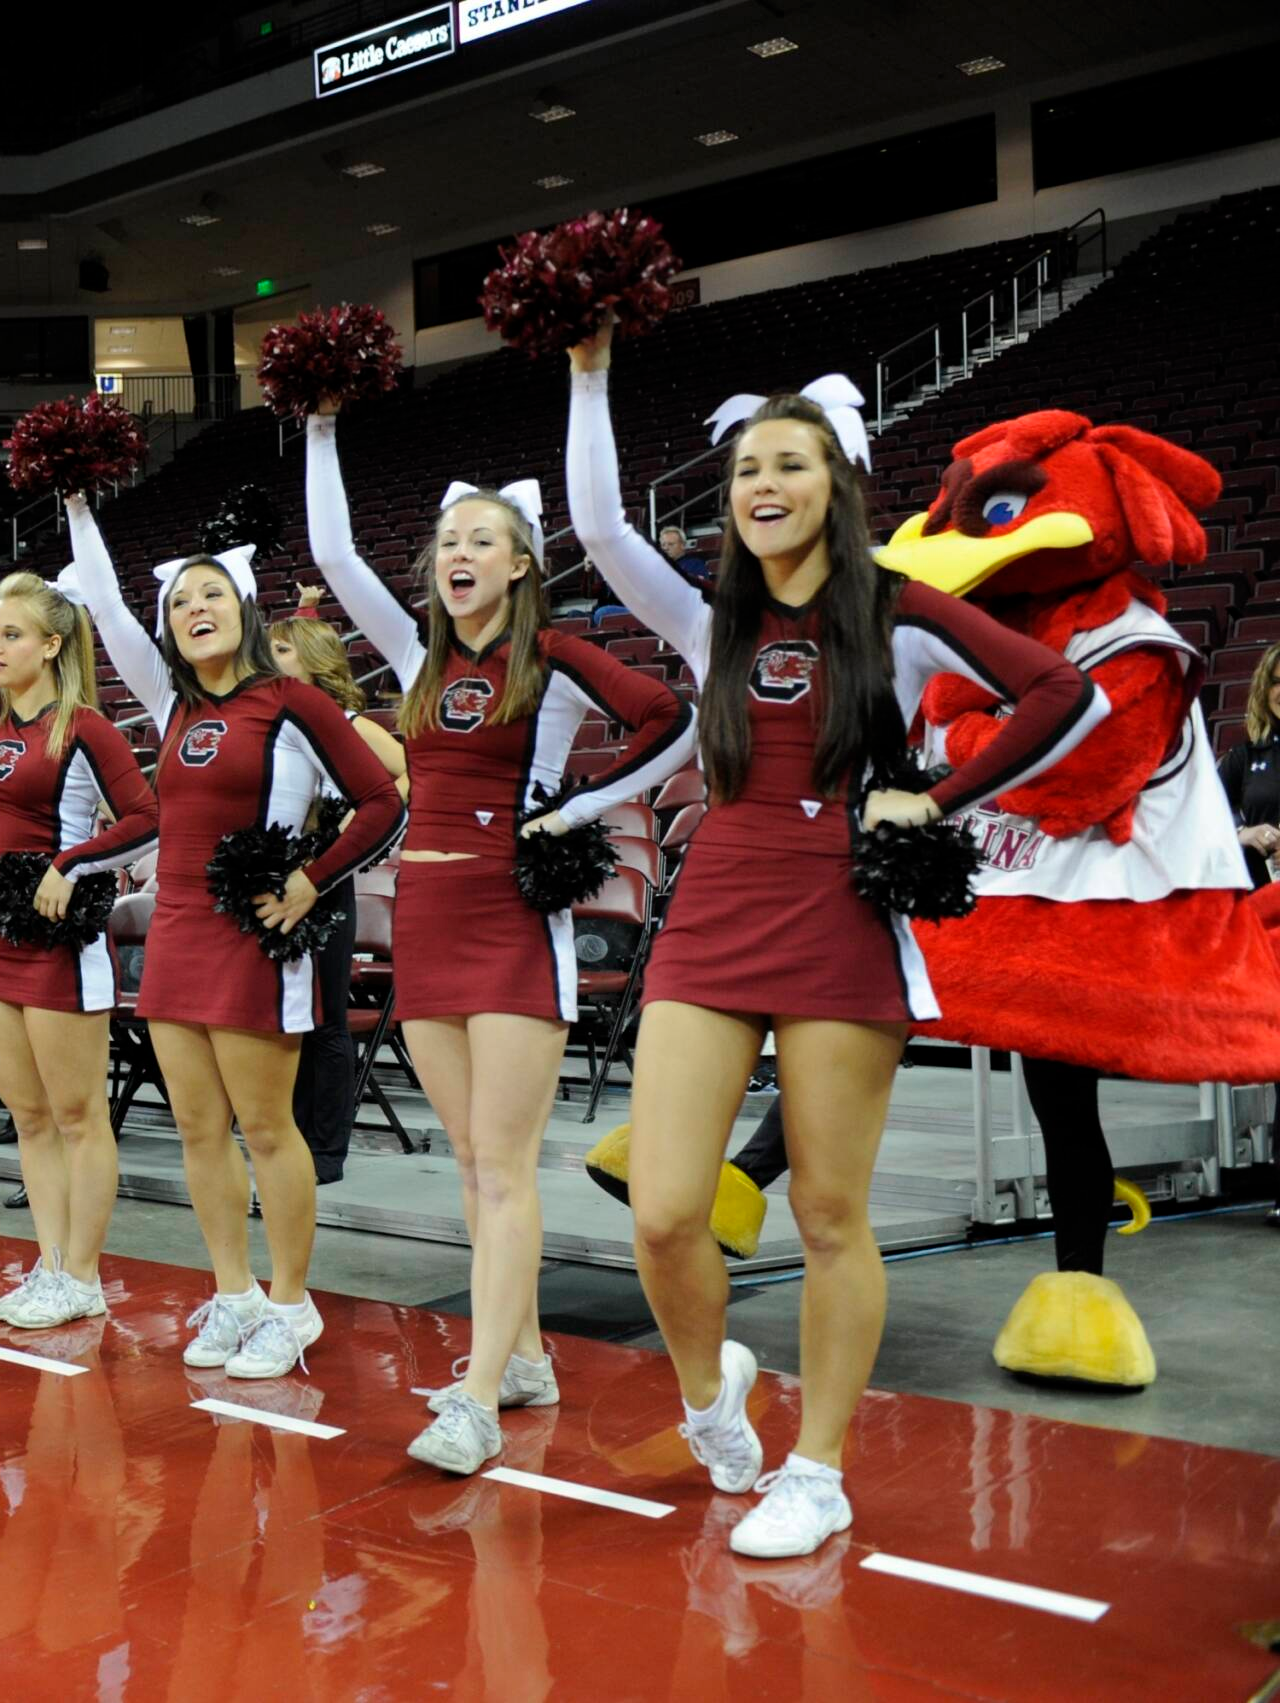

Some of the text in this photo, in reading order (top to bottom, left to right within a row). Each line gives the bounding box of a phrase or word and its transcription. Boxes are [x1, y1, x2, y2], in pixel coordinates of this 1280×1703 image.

[467, 0, 548, 27] STAN
[342, 22, 450, 77] Little Caesars
[953, 814, 1046, 872] INA
